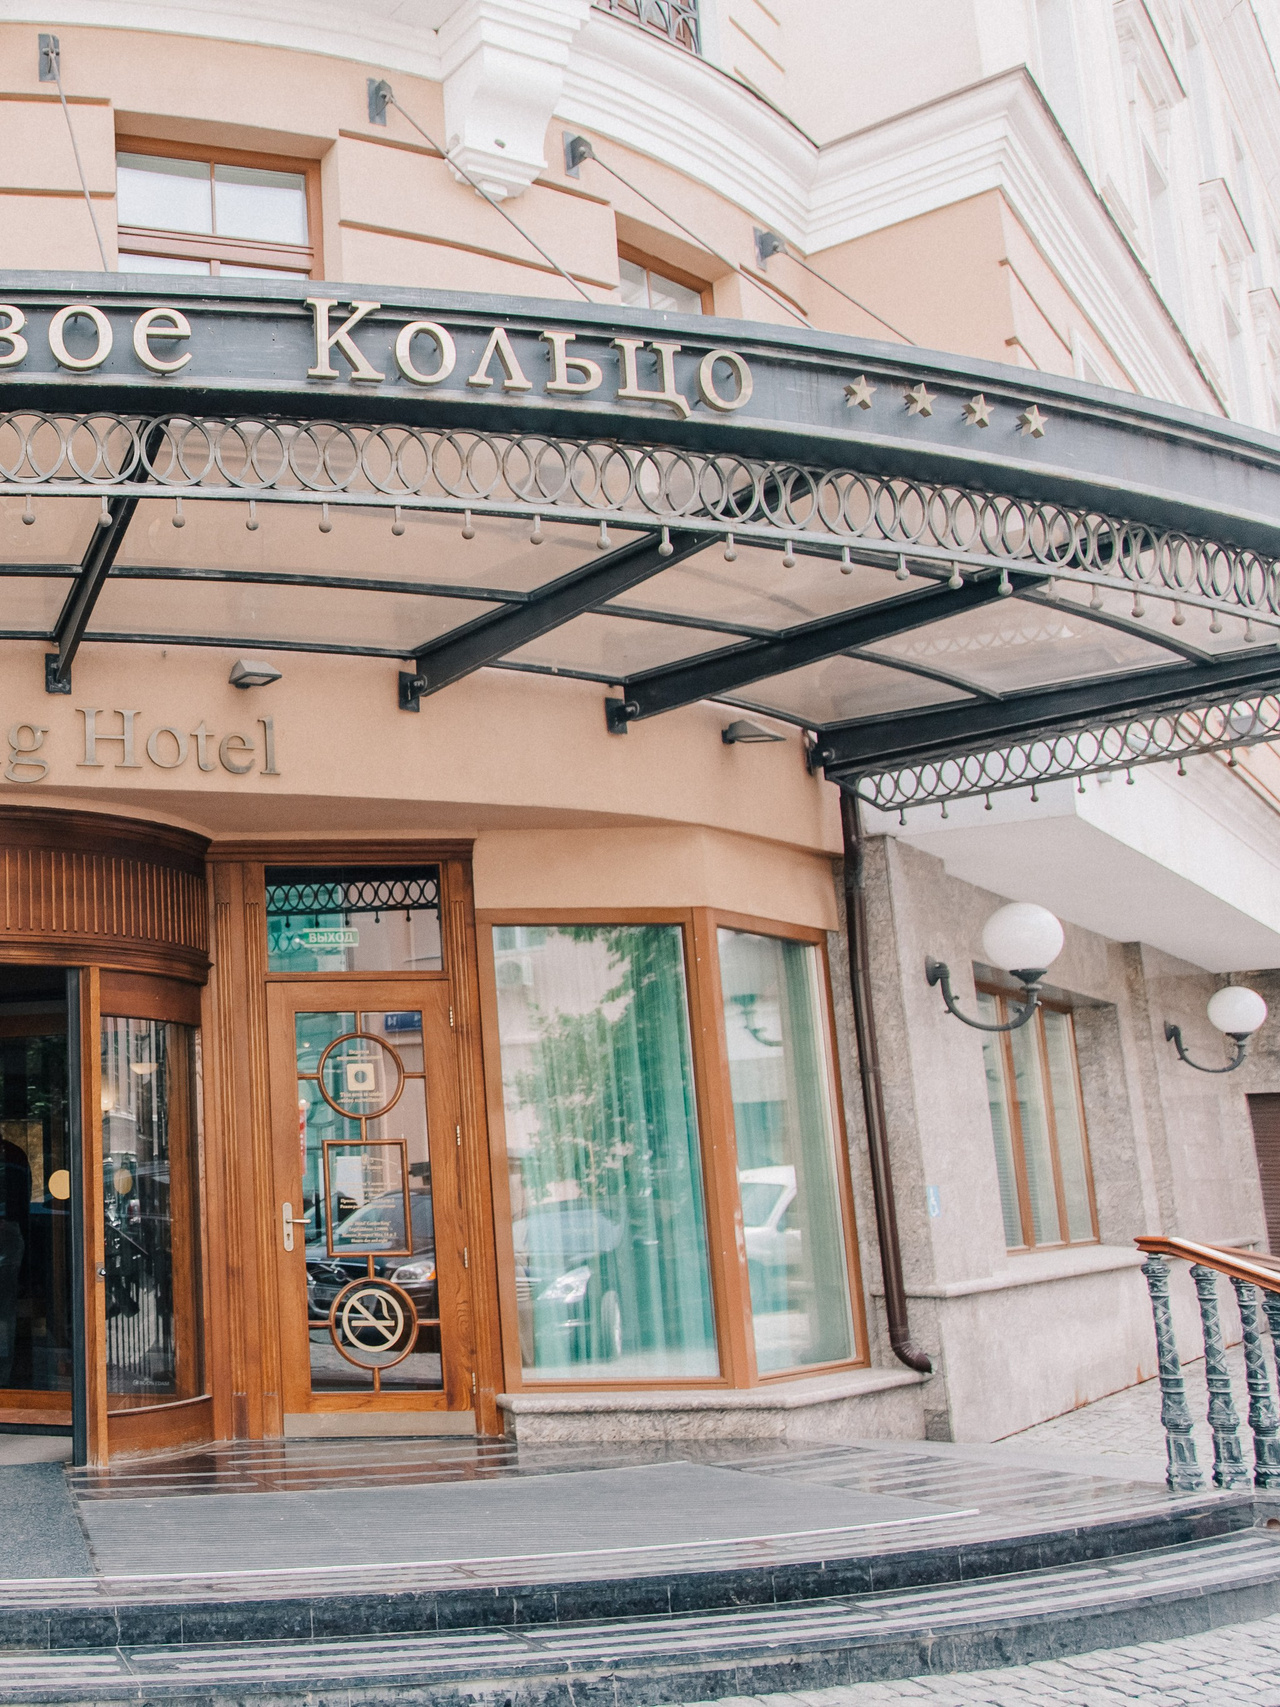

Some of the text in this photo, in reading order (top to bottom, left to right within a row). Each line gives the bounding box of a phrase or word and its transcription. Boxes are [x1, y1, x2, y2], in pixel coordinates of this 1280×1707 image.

[304, 297, 754, 421] Кольцо
[76, 707, 282, 777] Hotel
[309, 932, 354, 943] ВЫХОД
